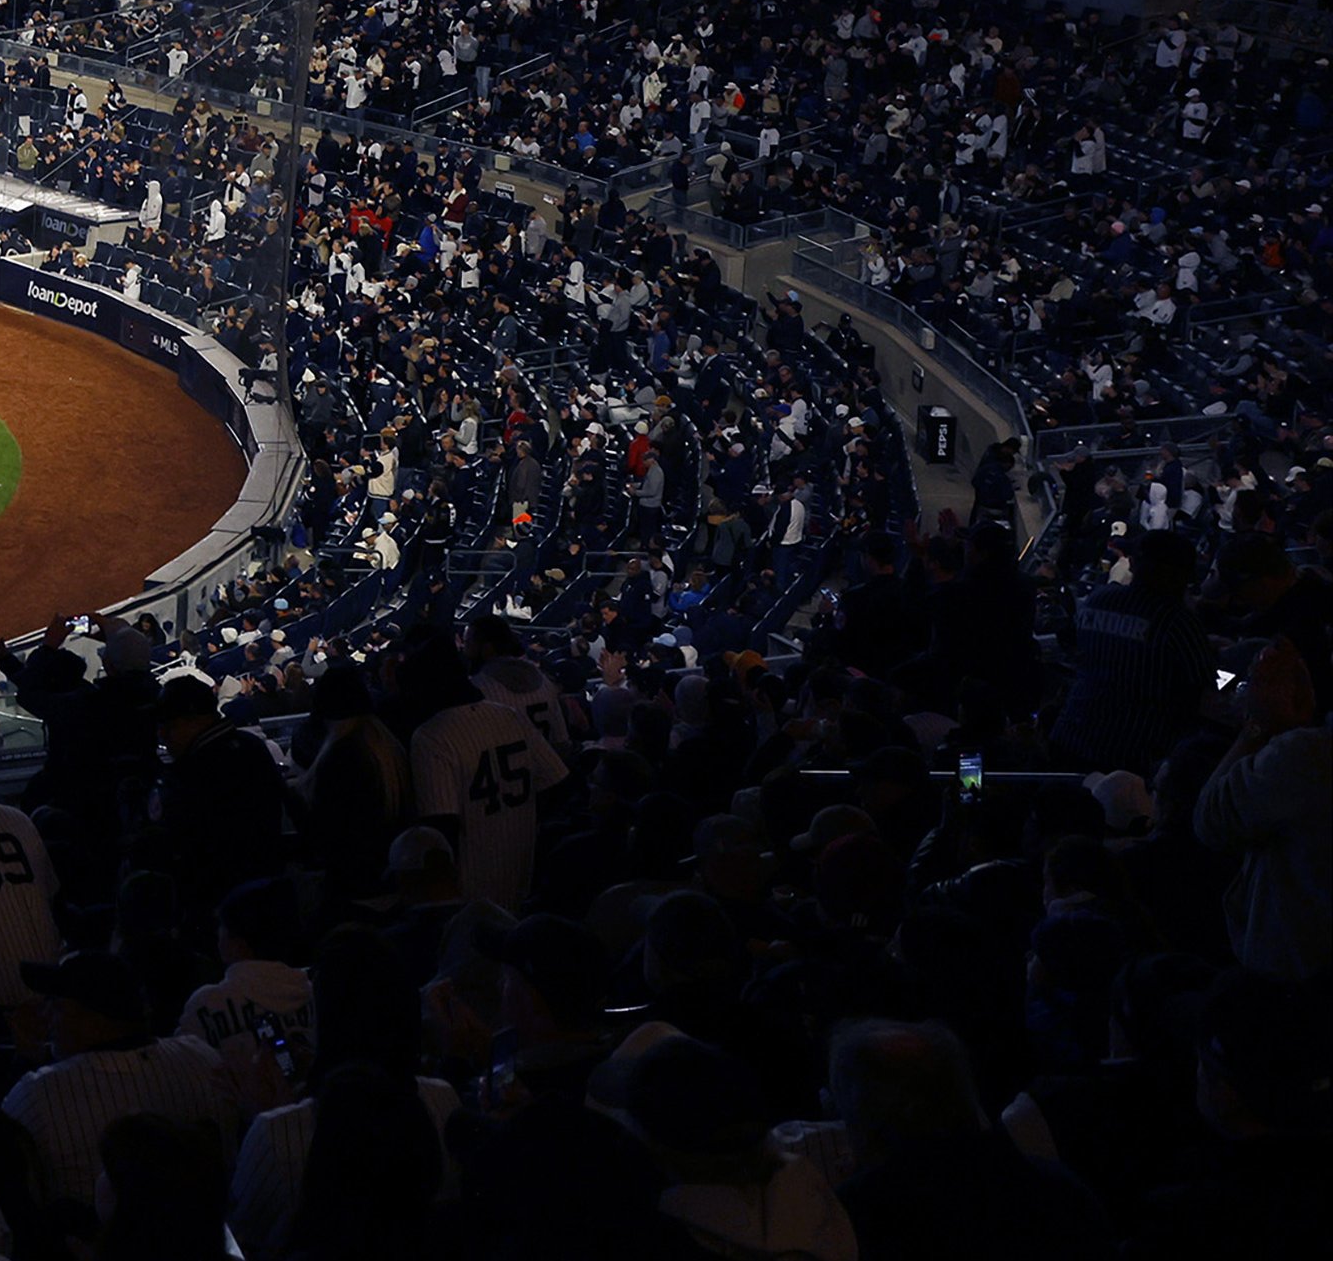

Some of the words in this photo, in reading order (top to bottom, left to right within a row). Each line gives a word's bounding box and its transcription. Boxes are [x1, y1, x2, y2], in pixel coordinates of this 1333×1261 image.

[27, 280, 99, 319] loanDepot
[160, 335, 181, 357] MLB
[937, 423, 948, 457] PEPSI
[469, 740, 531, 816] 45
